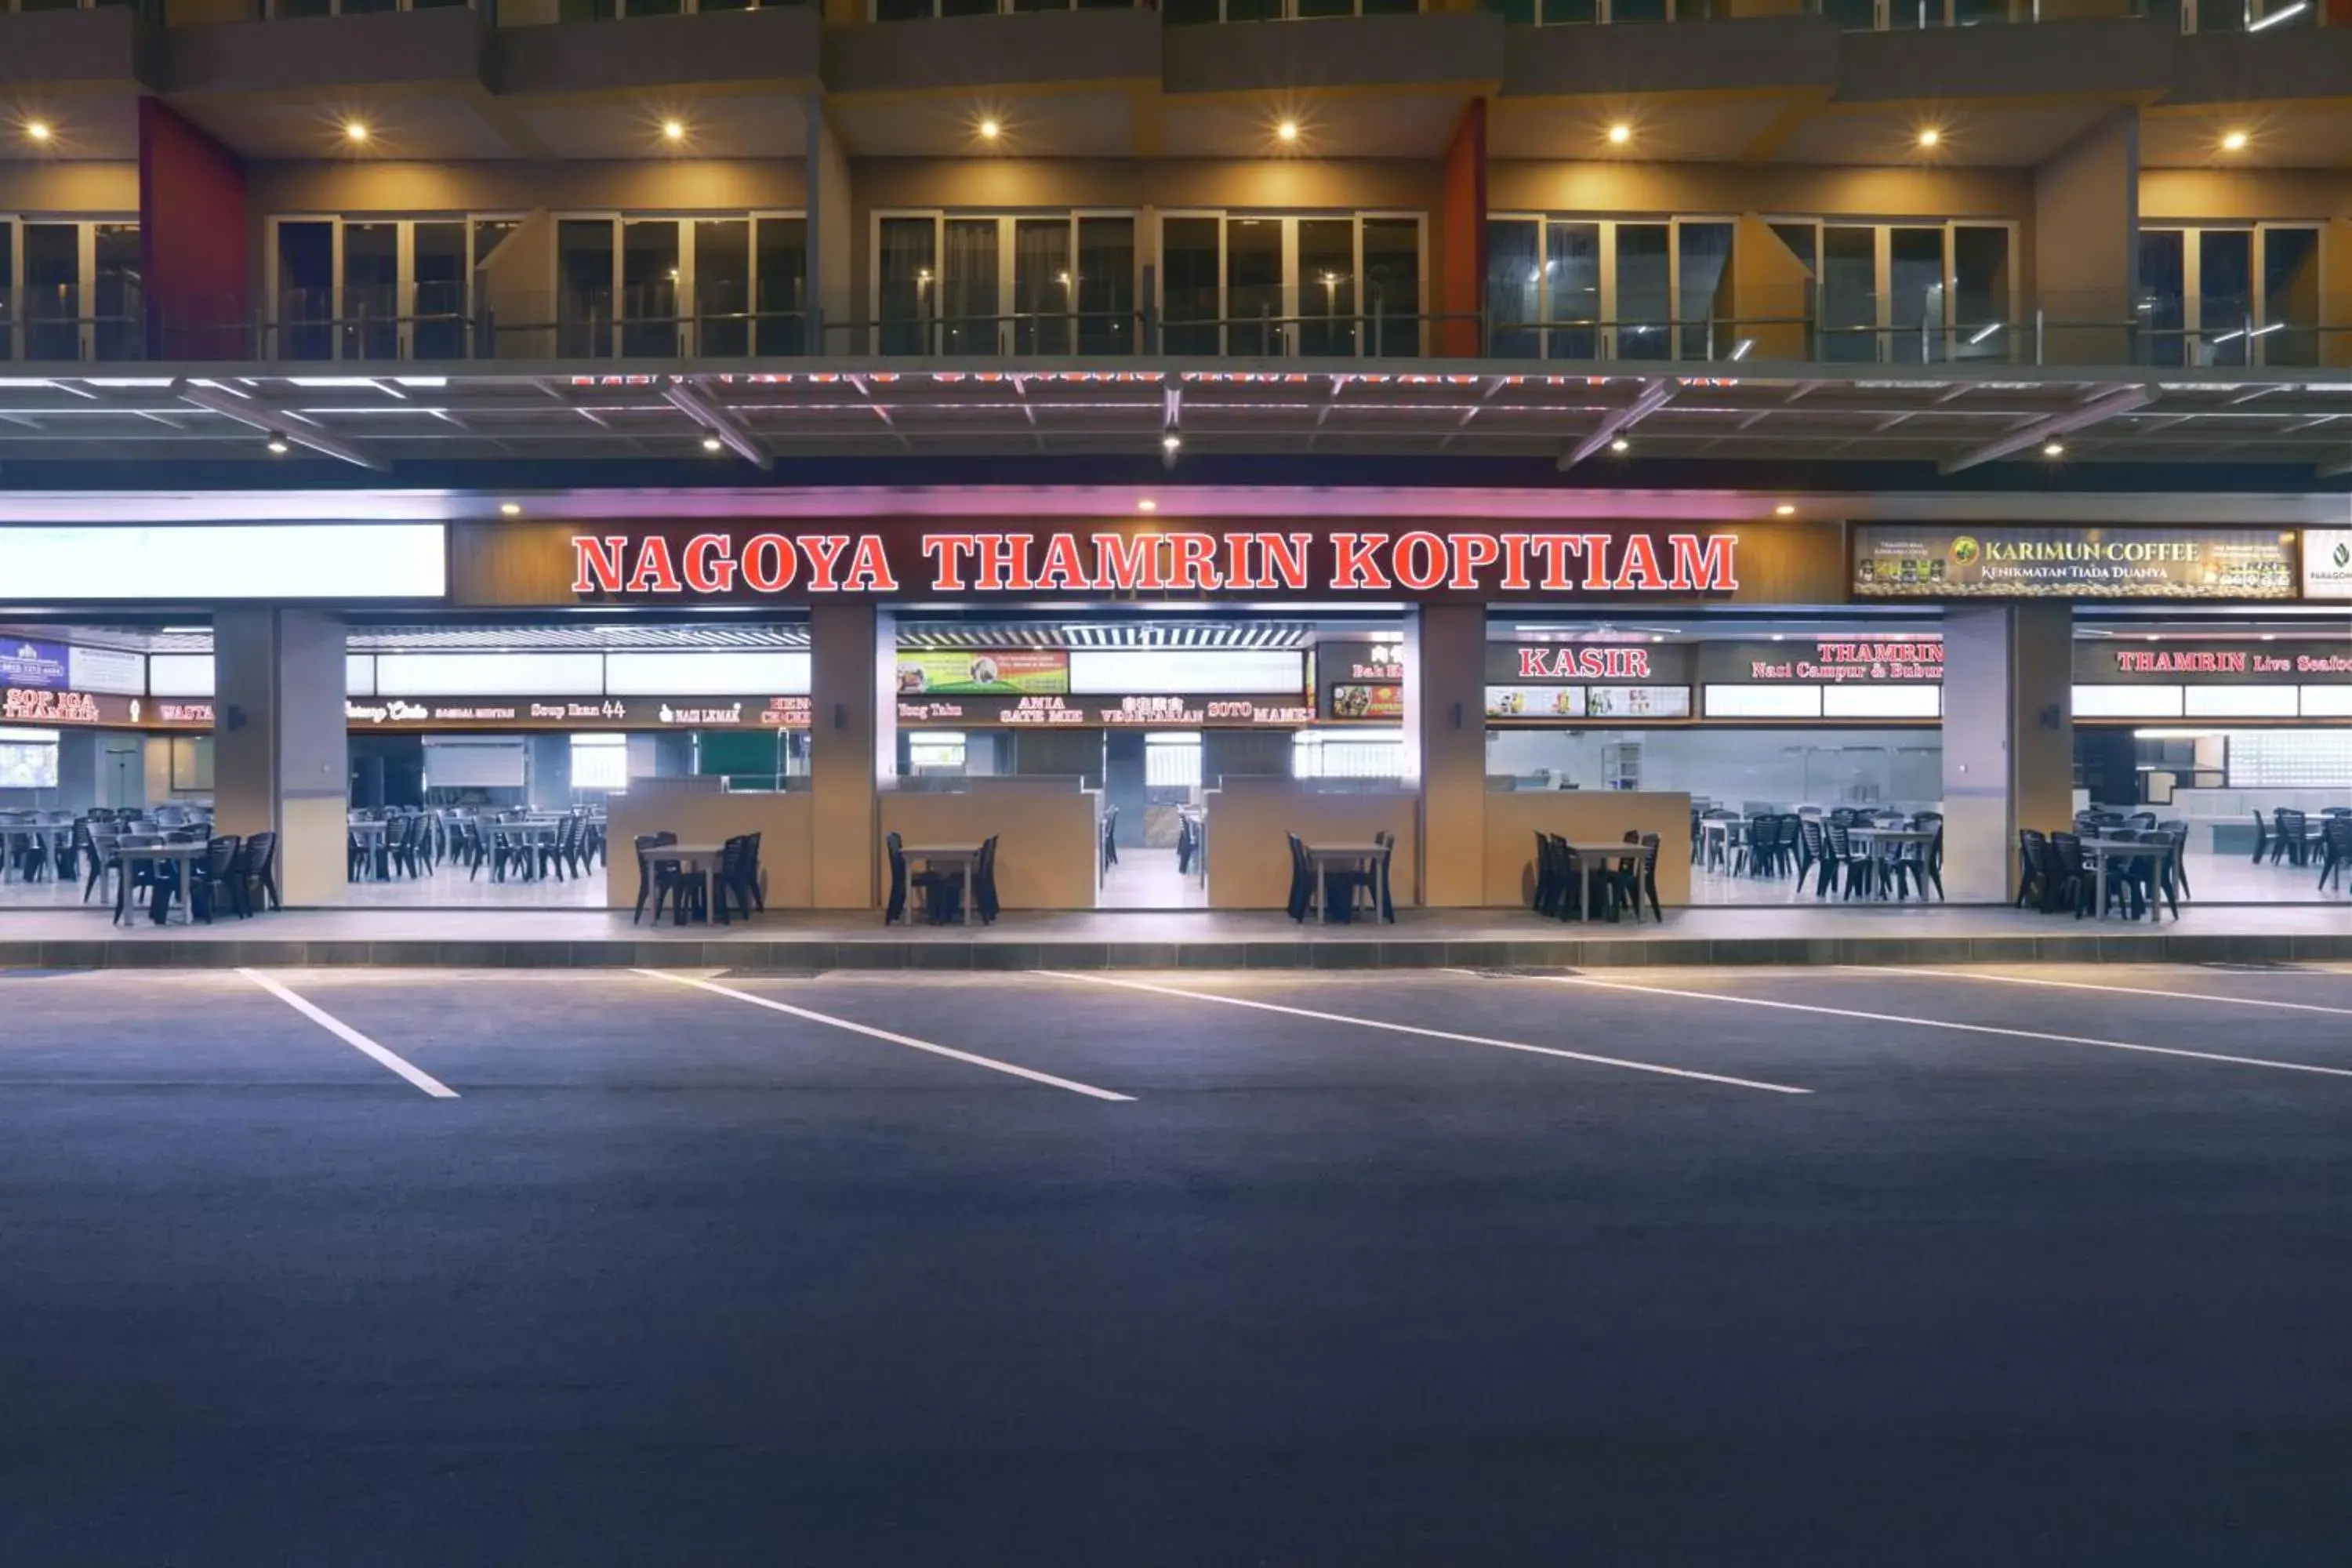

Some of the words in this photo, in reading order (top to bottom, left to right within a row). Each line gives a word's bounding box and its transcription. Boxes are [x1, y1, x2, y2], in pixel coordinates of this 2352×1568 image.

[1985, 541, 2100, 561] KARIMUN
[2107, 542, 2199, 561] COFFEE
[572, 533, 898, 593] NAGOYA
[923, 533, 1312, 591] THAMRIN
[1330, 531, 1739, 590] KOPITIAM
[1817, 643, 1944, 662] THAMRIN
[2117, 652, 2247, 672] THAMRIN
[2253, 655, 2290, 671] Live
[1518, 648, 1650, 678] KASIR
[1751, 662, 1792, 678] Nasi
[1796, 662, 1866, 682] Campur
[1870, 662, 1886, 678] &
[1889, 662, 1944, 678] Bubur
[7, 688, 53, 706] SOP
[57, 692, 96, 710] IGA
[1207, 701, 1253, 717] SOTO
[601, 700, 626, 719] 44
